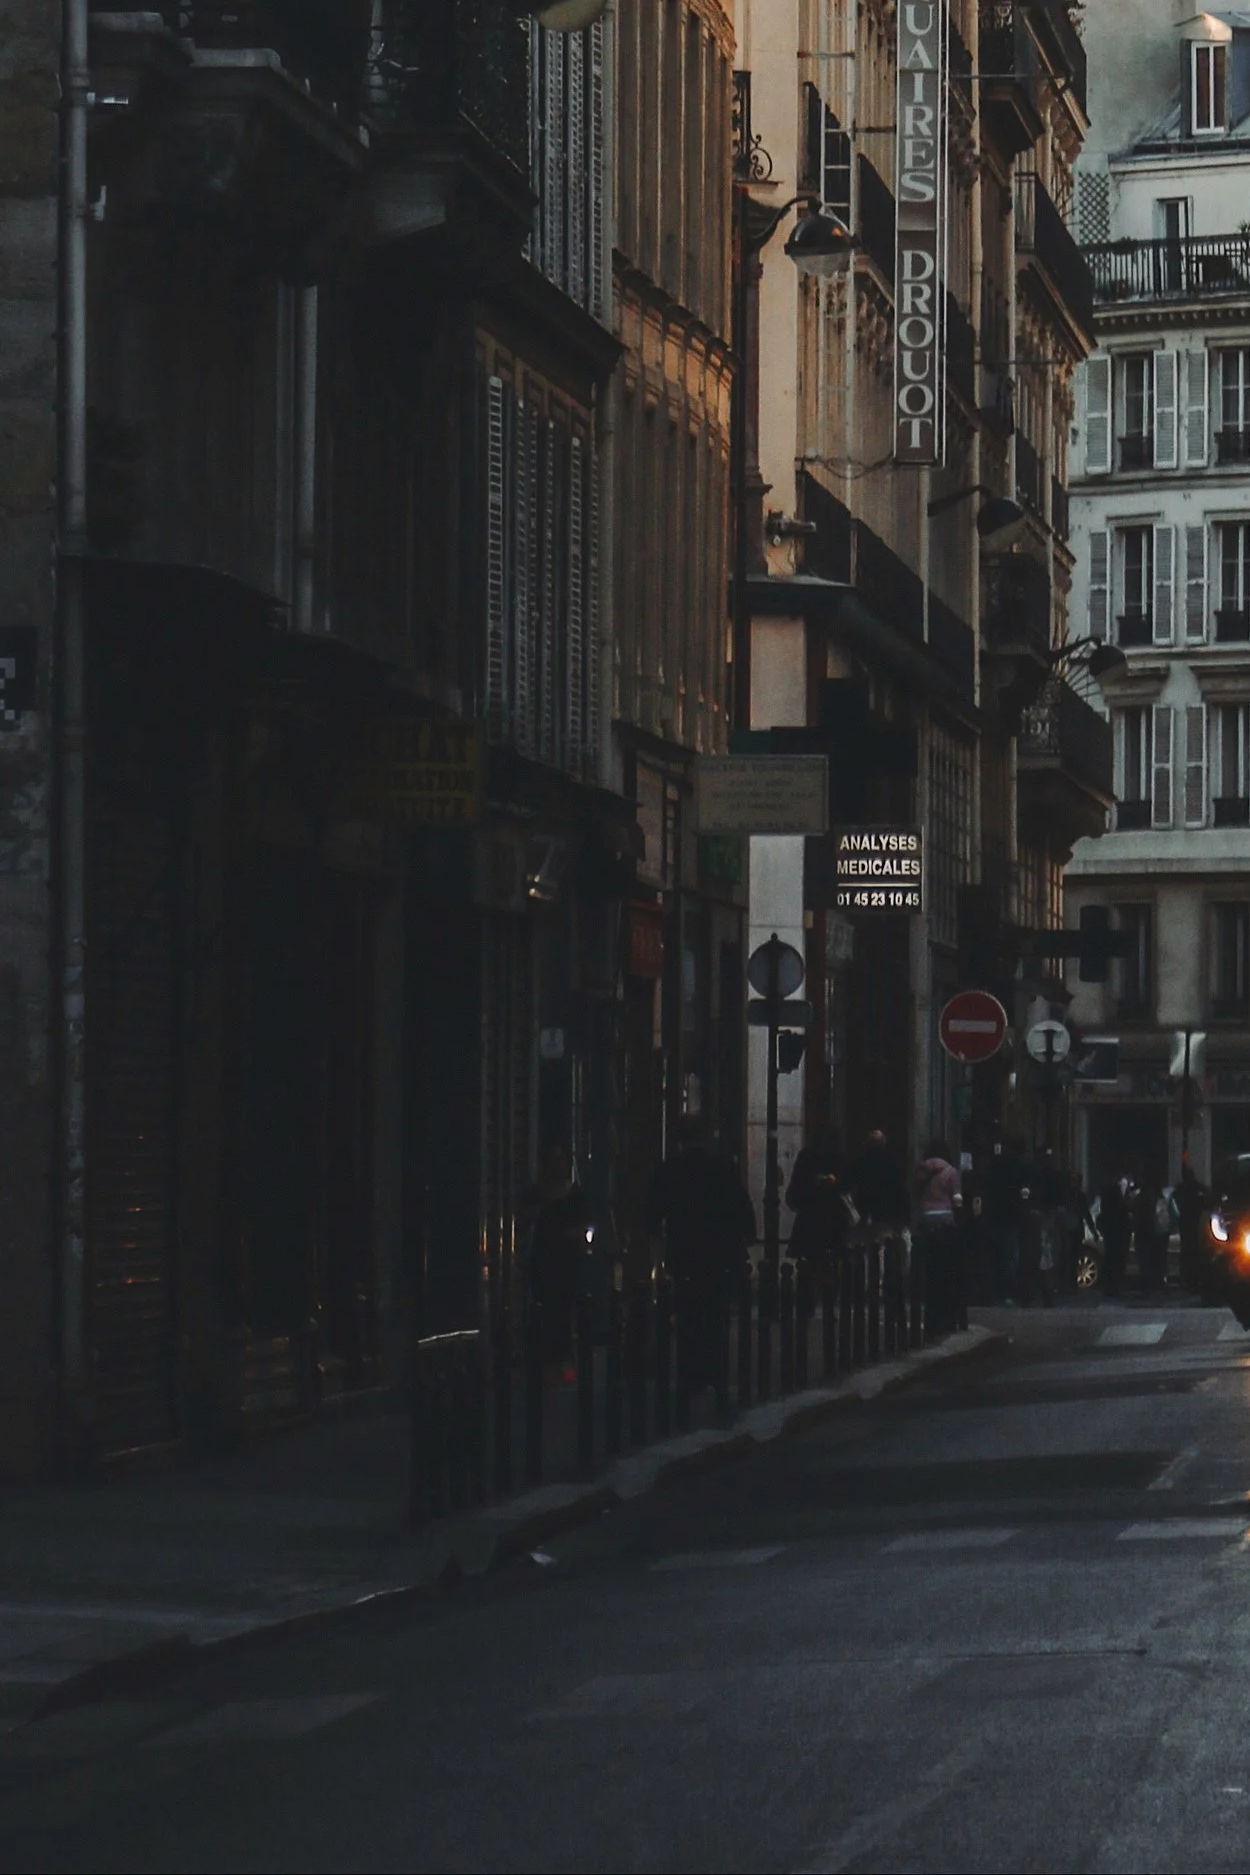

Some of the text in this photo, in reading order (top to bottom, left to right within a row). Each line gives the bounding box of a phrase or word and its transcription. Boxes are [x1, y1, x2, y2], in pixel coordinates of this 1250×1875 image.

[898, 249, 937, 449] DROUOT
[839, 834, 918, 851] ANALYSES
[836, 859, 921, 876] MEDICALES
[837, 892, 920, 906] 01 45 23 10 45
